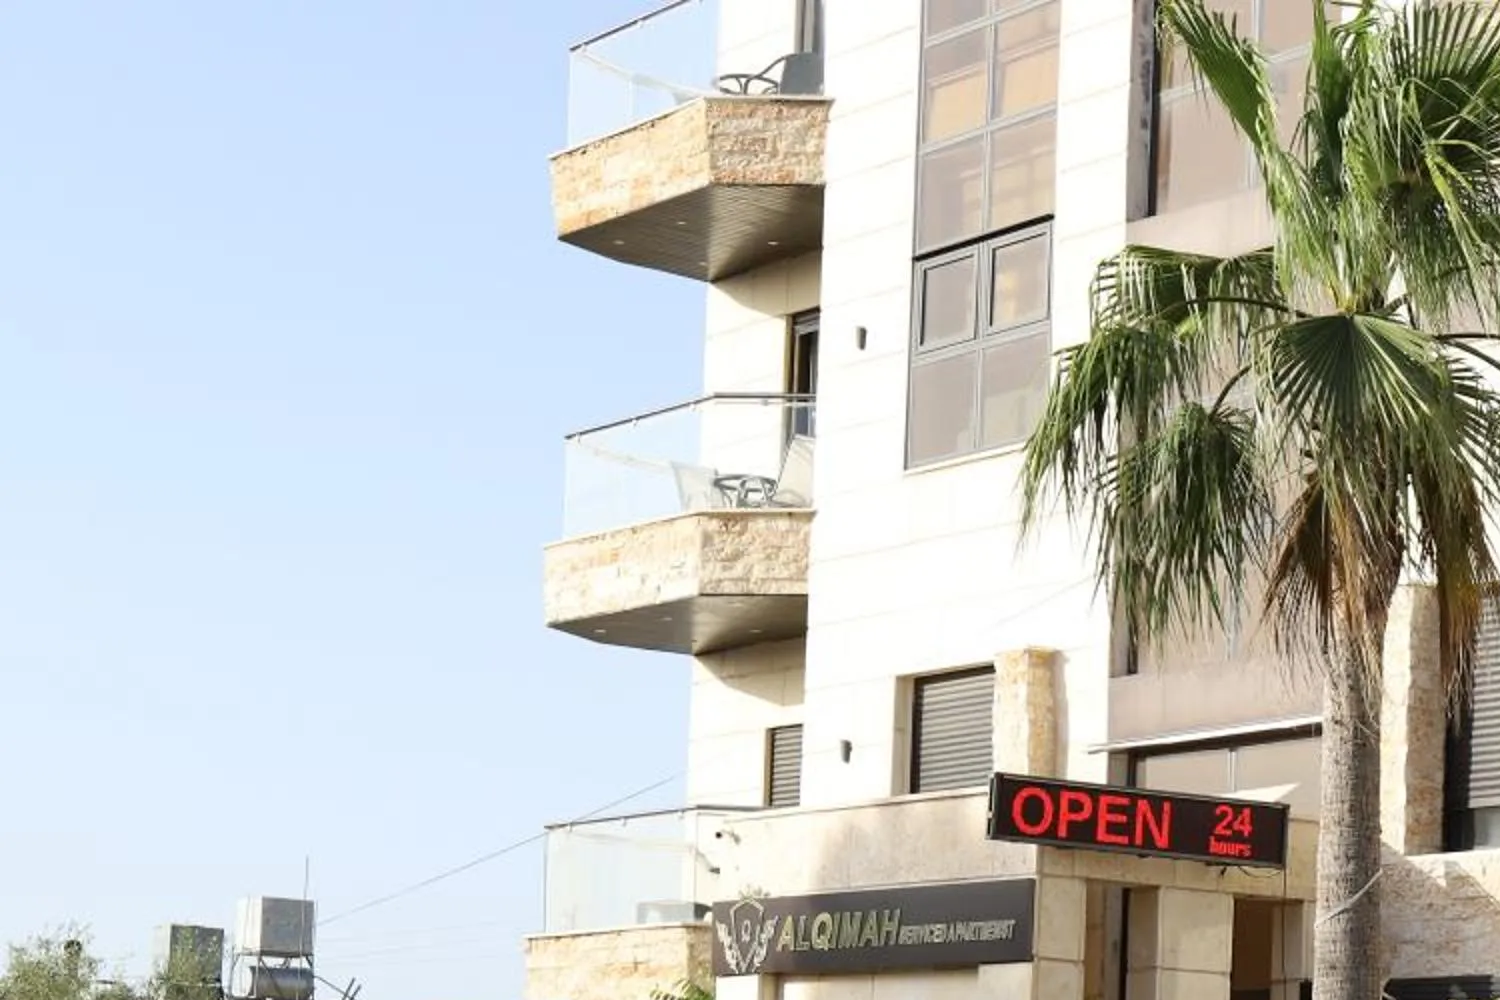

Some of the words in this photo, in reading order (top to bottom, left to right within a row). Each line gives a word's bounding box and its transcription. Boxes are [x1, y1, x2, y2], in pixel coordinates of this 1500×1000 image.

[1011, 786, 1172, 849] OPEN
[1213, 803, 1253, 837] 24
[1208, 836, 1252, 857] hours
[776, 908, 901, 952] ALQIMAH
